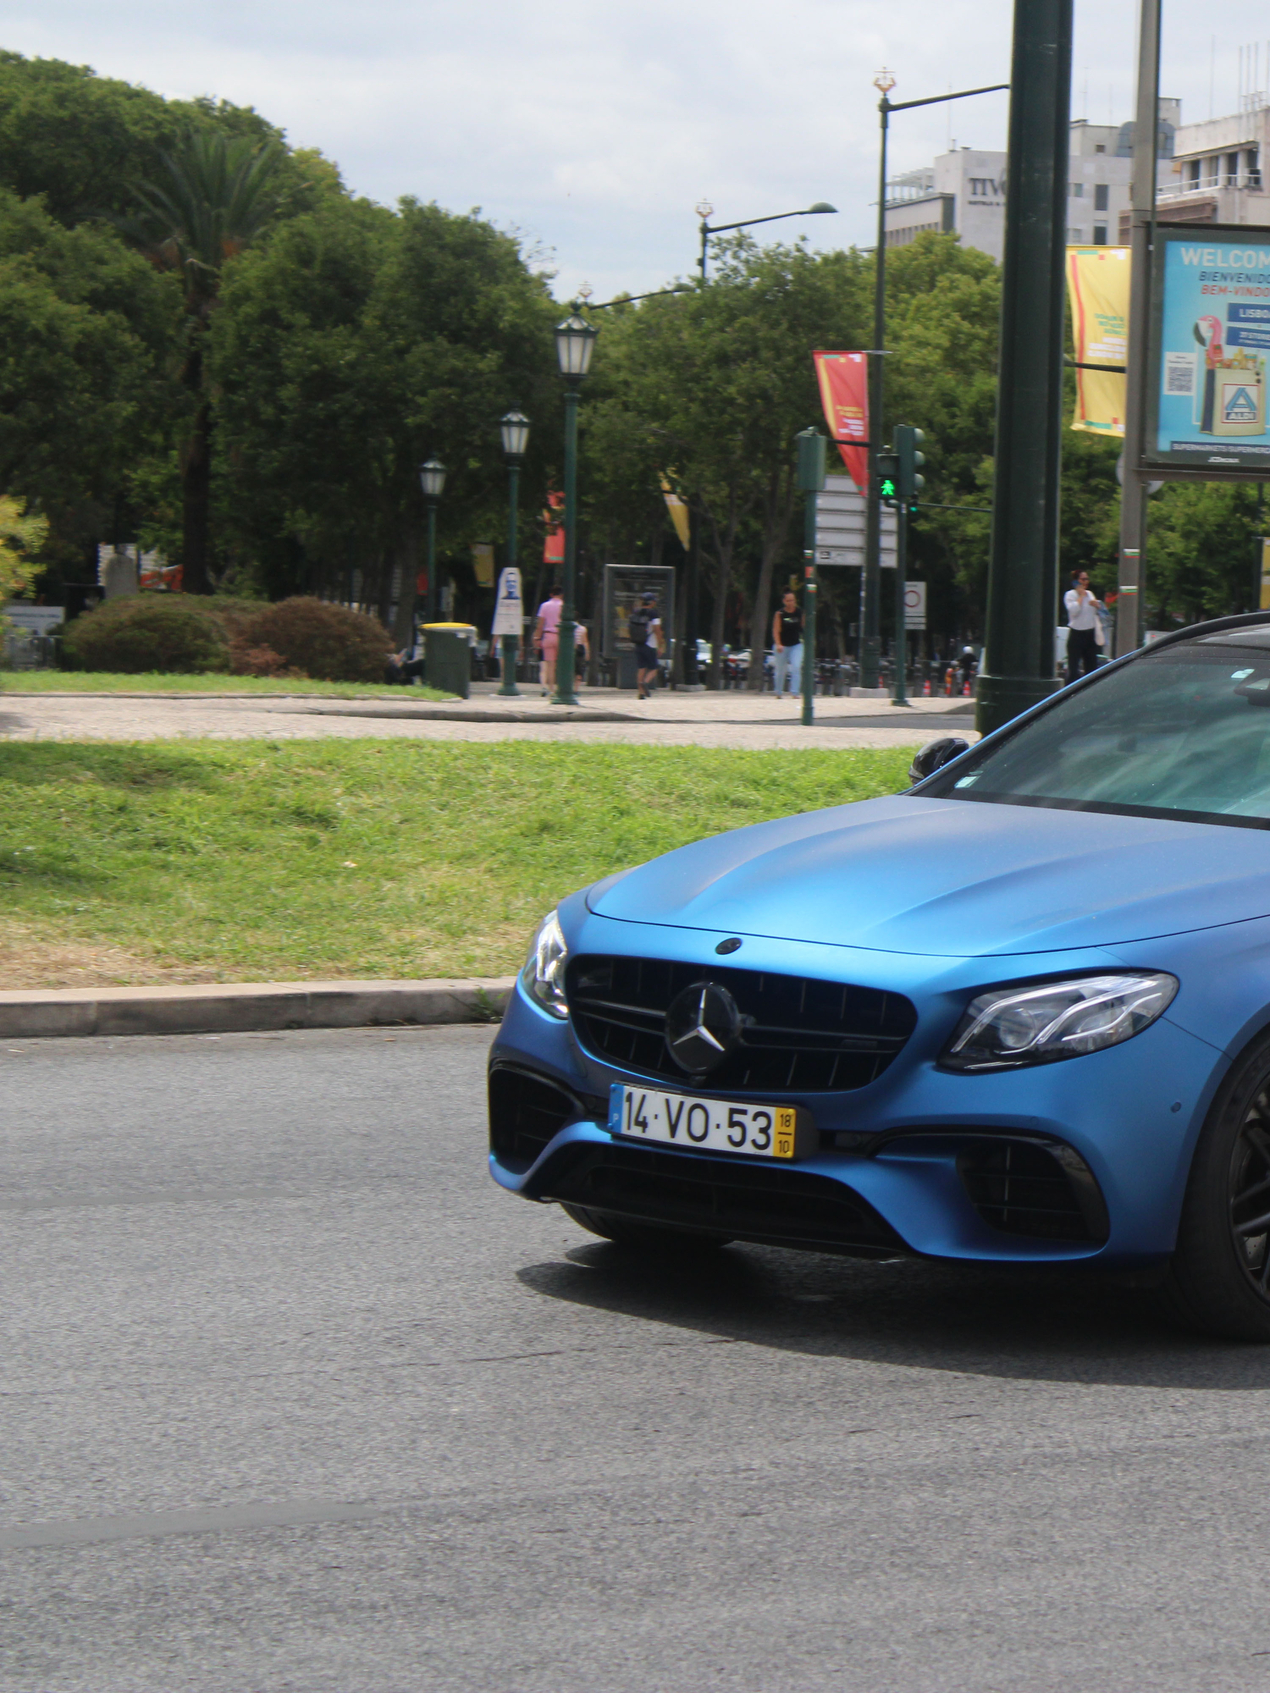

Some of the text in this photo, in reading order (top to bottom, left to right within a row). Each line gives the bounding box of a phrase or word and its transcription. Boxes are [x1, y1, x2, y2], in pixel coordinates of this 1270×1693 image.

[1228, 412, 1255, 420] ALDI
[780, 1113, 791, 1128] 18
[777, 1140, 790, 1155] 10
